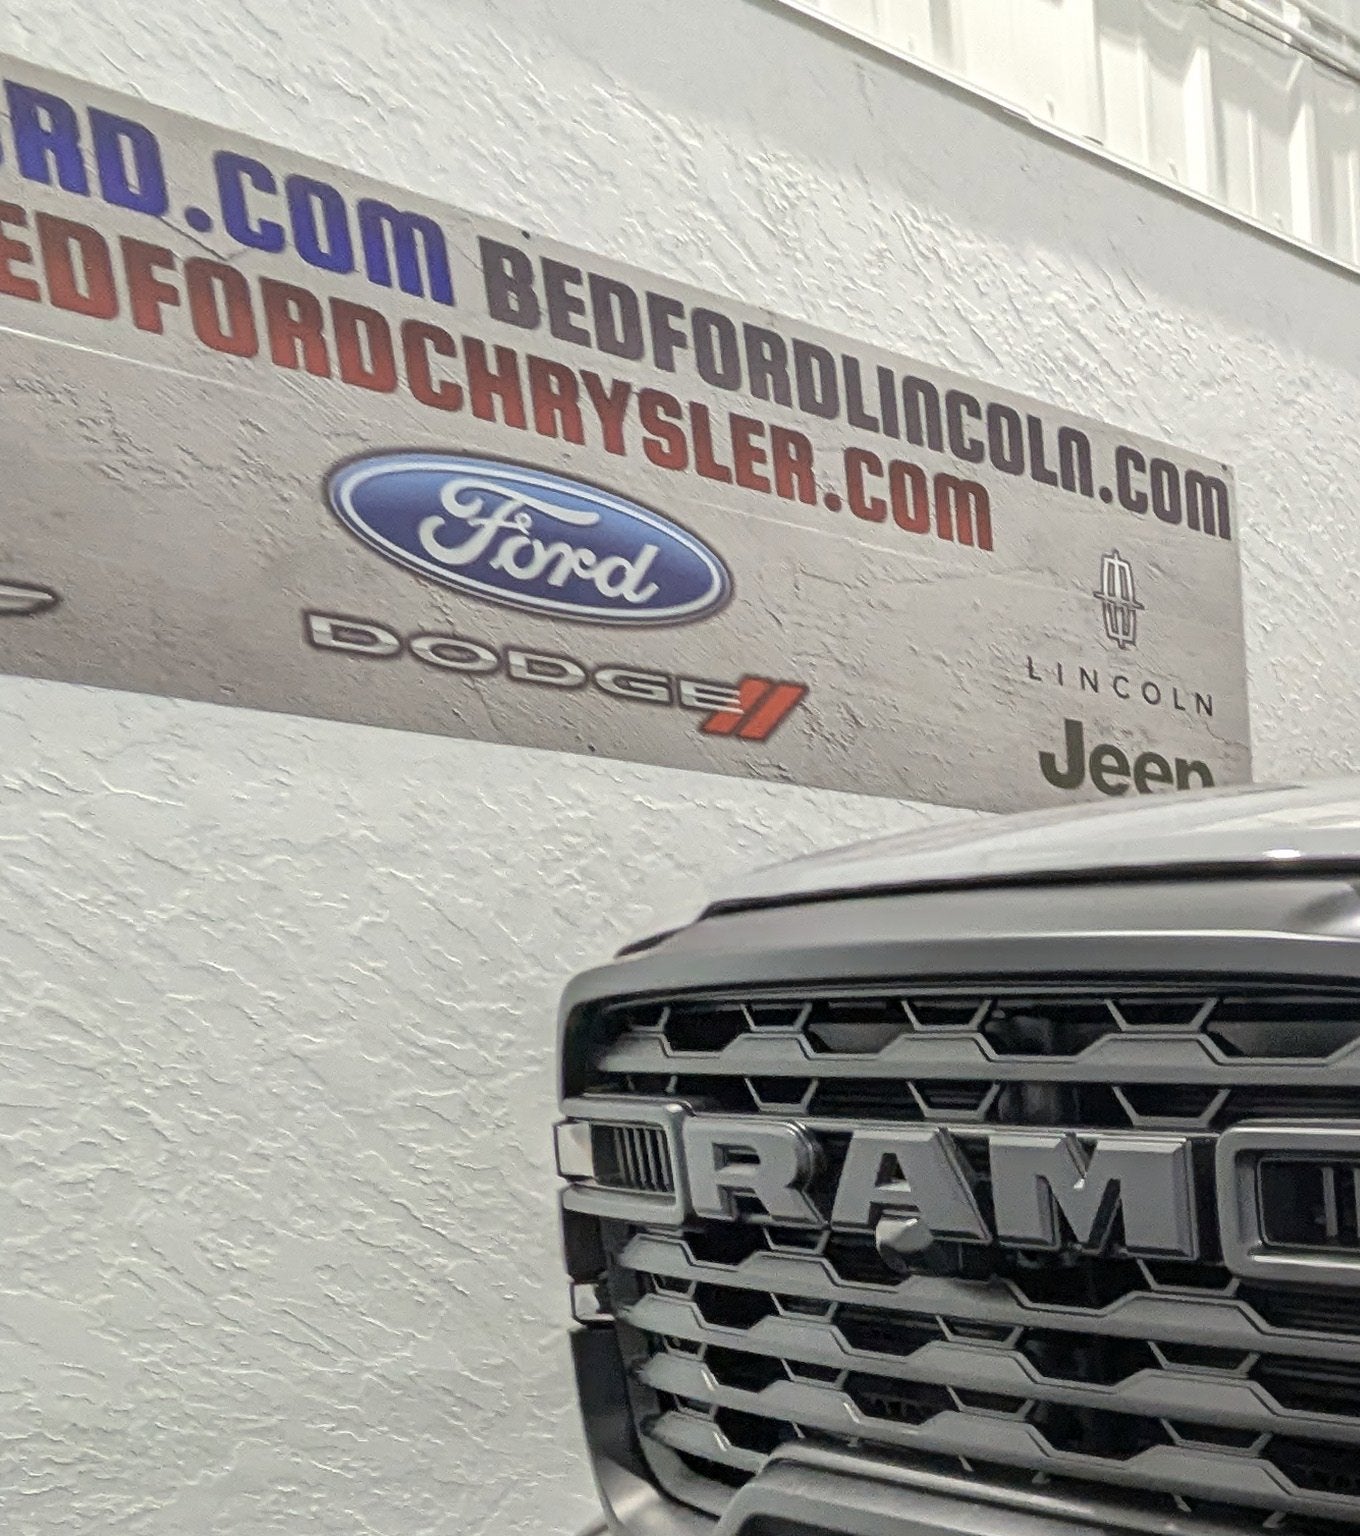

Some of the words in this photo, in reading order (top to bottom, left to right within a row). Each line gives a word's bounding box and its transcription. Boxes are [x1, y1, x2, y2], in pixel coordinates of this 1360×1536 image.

[0, 79, 455, 307] RD.COM
[478, 234, 1232, 541] BEDFORDLINCOLN.COM
[418, 478, 660, 603] Ford
[306, 611, 742, 715] DODGE
[1027, 655, 1214, 717] LINCOLN
[682, 1117, 1198, 1261] RAM
